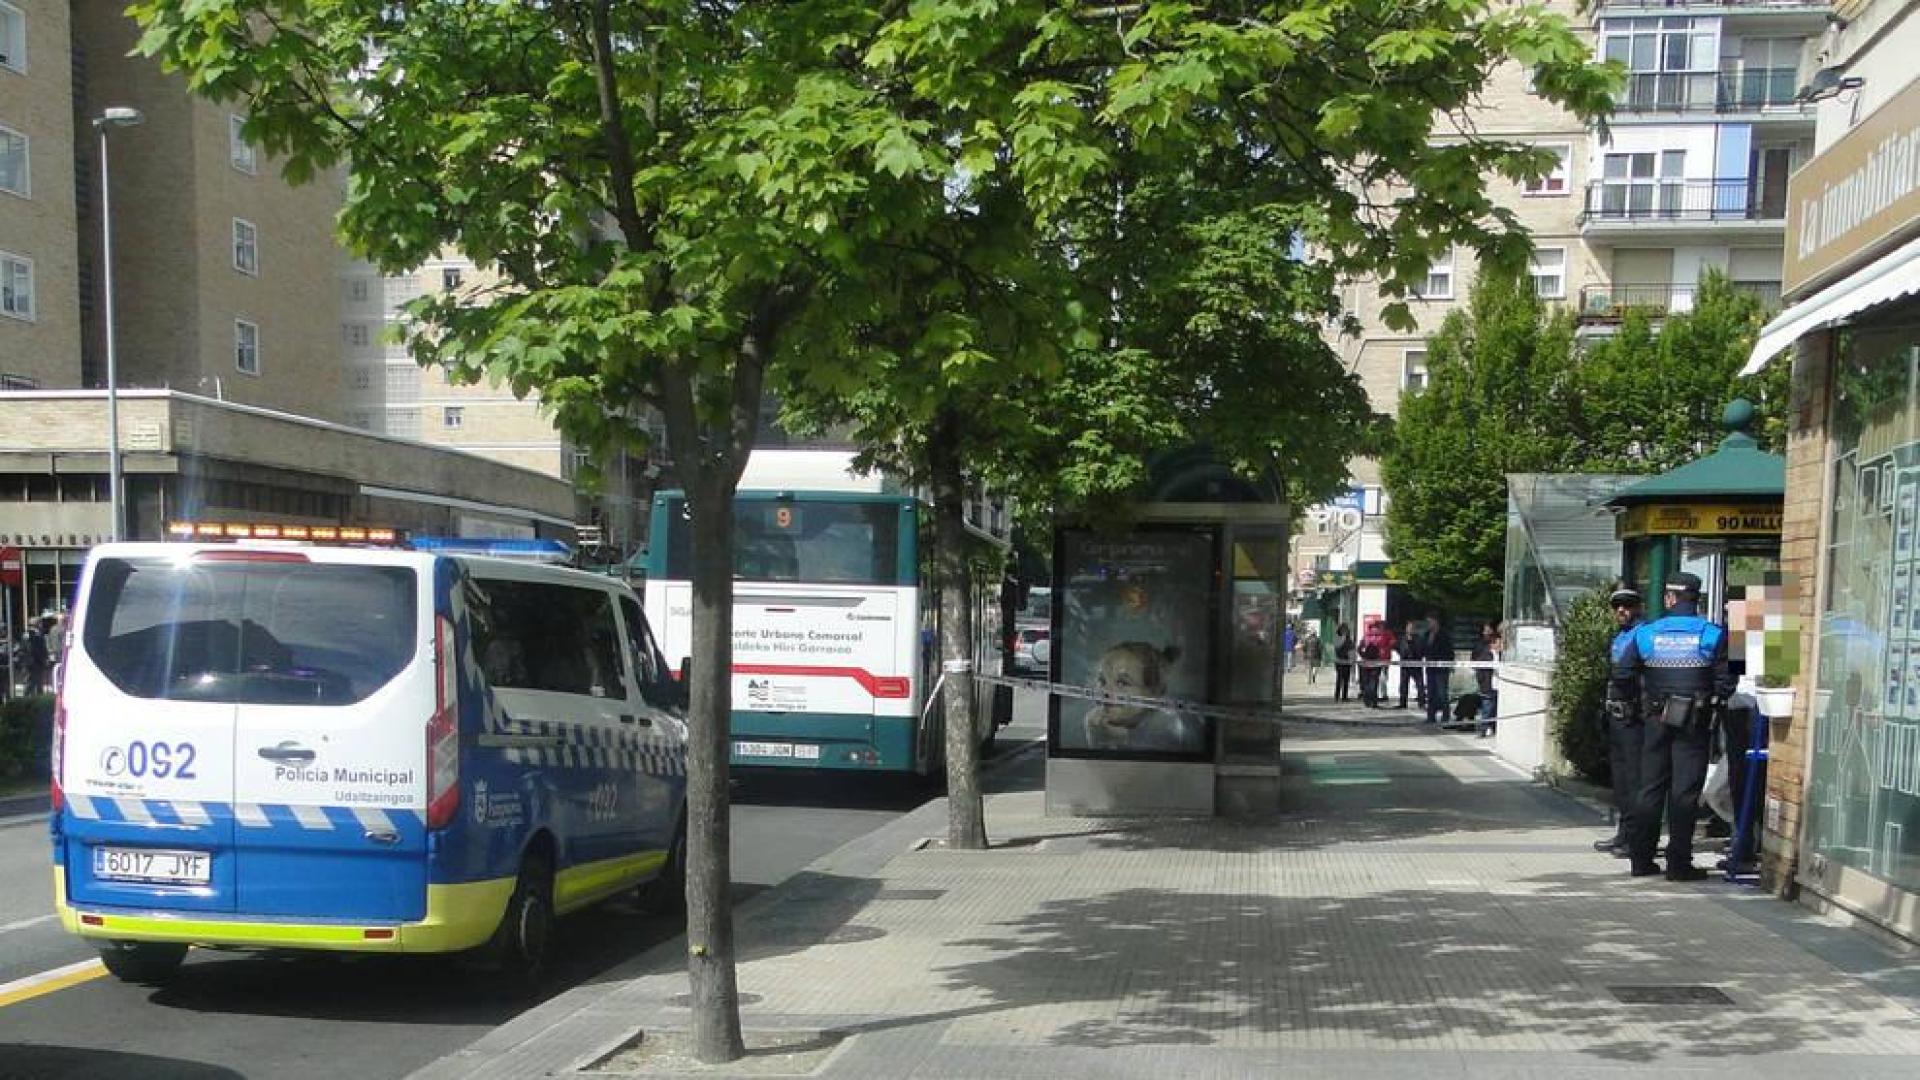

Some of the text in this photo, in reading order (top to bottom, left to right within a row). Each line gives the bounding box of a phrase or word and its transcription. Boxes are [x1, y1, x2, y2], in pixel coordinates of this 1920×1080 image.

[1798, 199, 1819, 260] La
[777, 507, 791, 528] 9
[1716, 516, 1740, 530] 90
[128, 740, 196, 779] 092
[334, 768, 414, 786] Municipal
[109, 853, 205, 877] 6017 JYF
